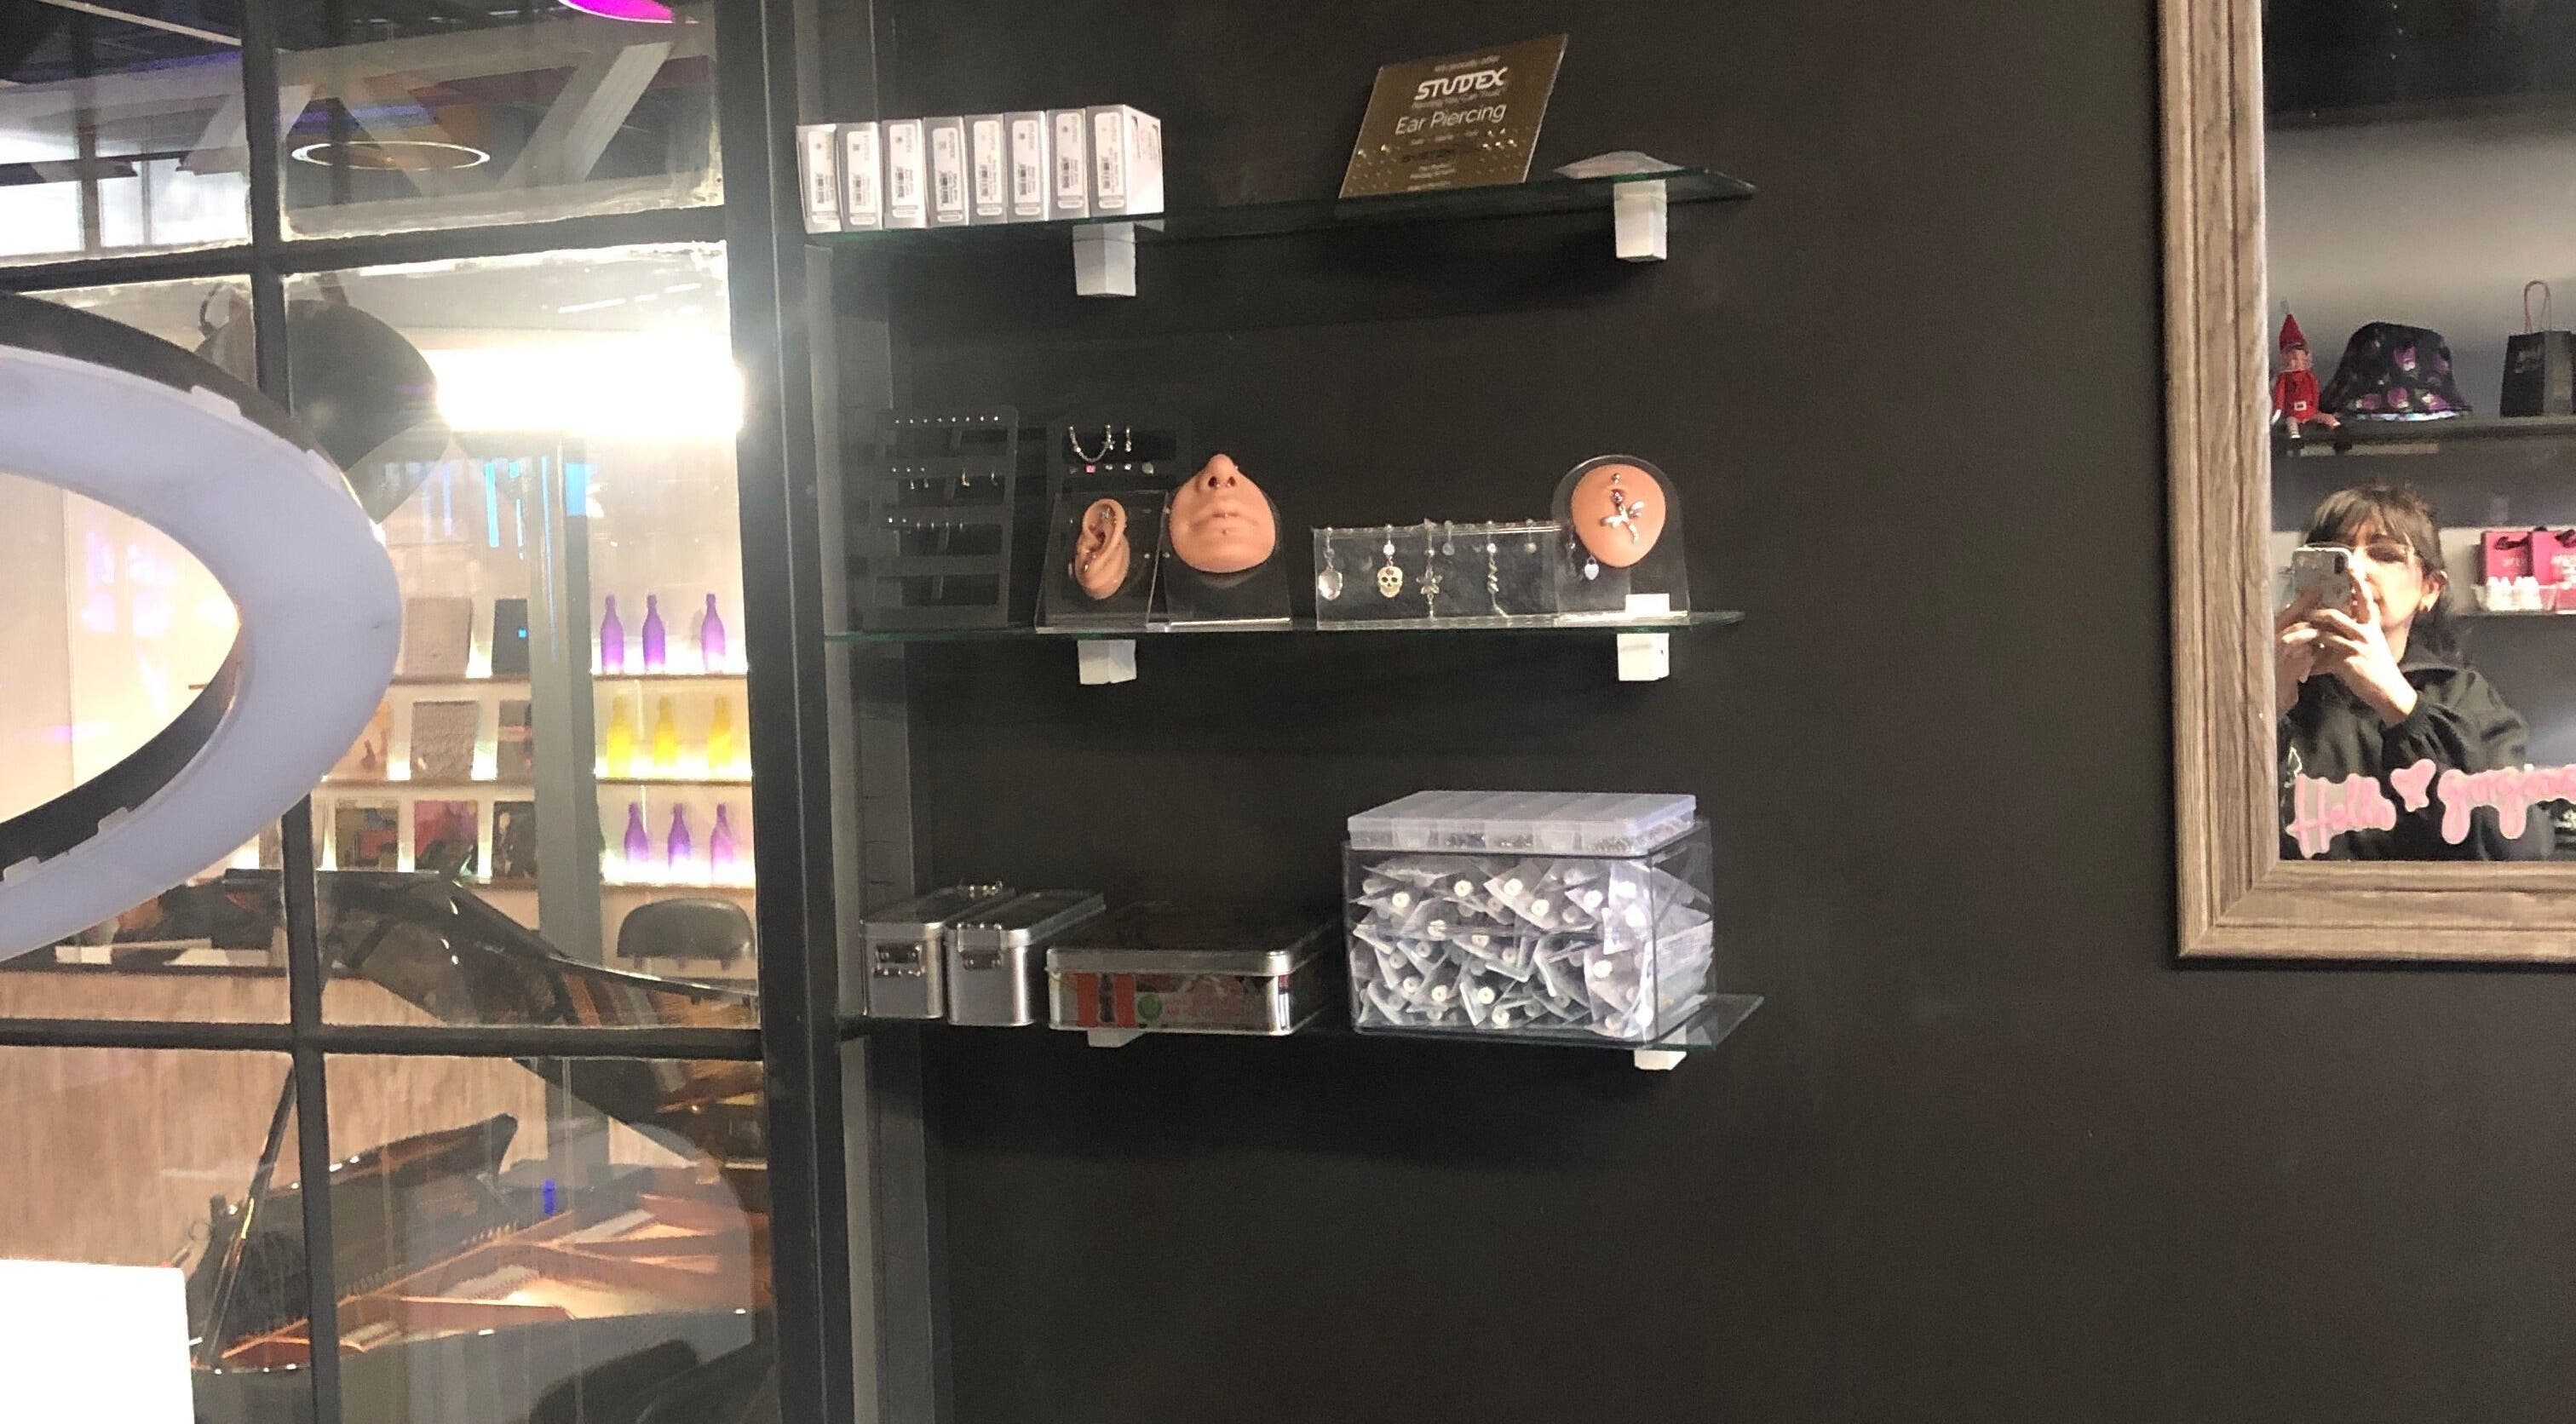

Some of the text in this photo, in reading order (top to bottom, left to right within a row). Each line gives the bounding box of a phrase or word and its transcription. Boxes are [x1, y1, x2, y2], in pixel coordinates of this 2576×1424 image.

[1413, 66, 1508, 100] STUDEX
[1394, 104, 1507, 135] Ear Piercing
